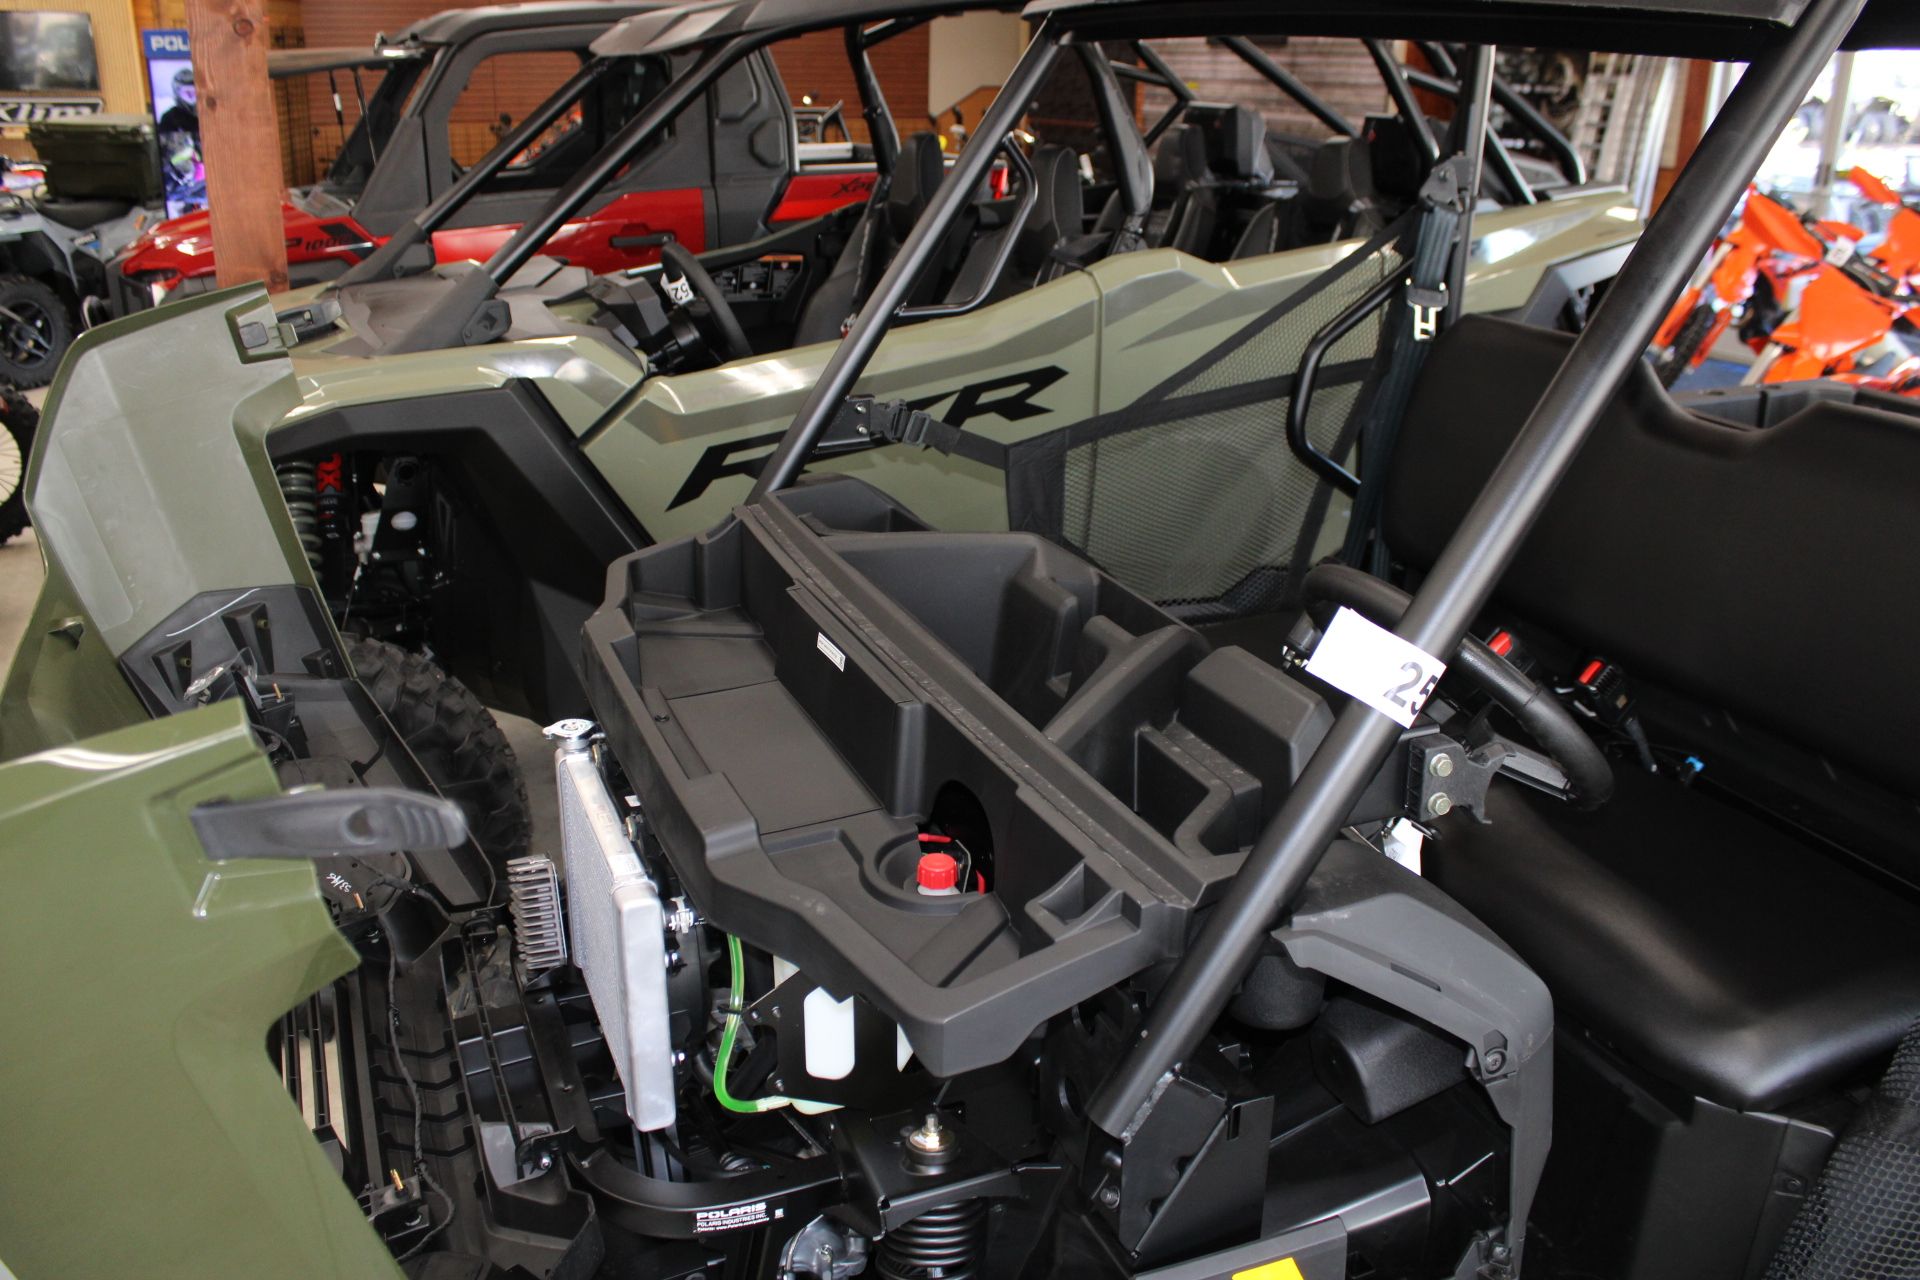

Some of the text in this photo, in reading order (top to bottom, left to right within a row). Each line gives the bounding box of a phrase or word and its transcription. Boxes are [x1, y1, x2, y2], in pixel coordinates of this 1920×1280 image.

[1383, 661, 1439, 716] 25
[696, 1202, 767, 1220] POLARIS
[722, 1215, 755, 1225] INDUSTRIES
